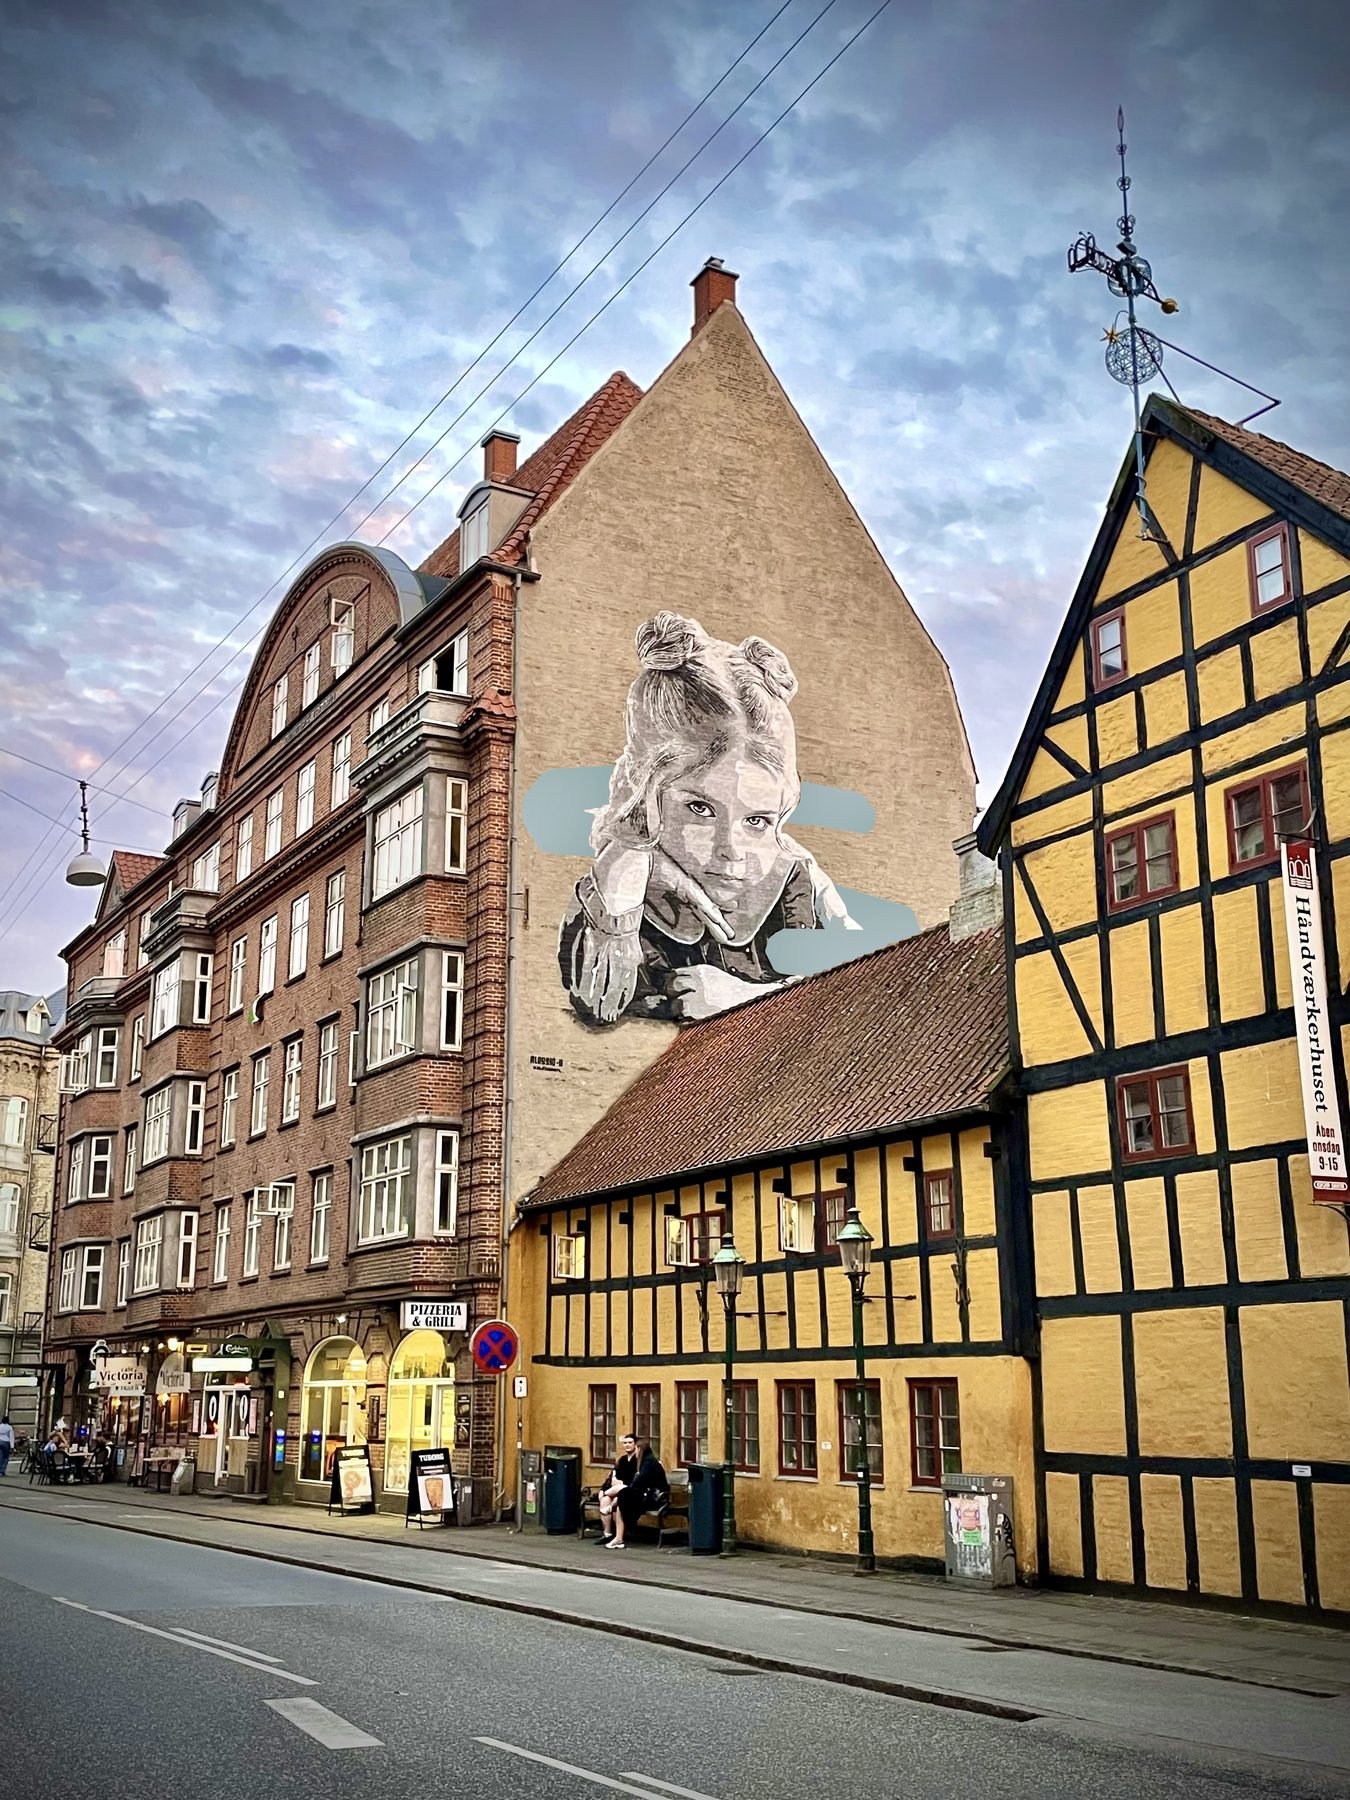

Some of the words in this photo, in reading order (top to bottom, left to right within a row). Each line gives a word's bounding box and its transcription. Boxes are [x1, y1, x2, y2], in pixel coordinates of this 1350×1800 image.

[1295, 896, 1328, 1113] Håndværkerhuset
[1316, 1121, 1335, 1138] Åben
[1312, 1140, 1341, 1155] onsdag
[1318, 1156, 1339, 1171] 9-15
[410, 1304, 462, 1316] PIZZERIA
[412, 1316, 421, 1327] &
[425, 1316, 456, 1328] GRILL
[99, 1369, 143, 1381] Victoria
